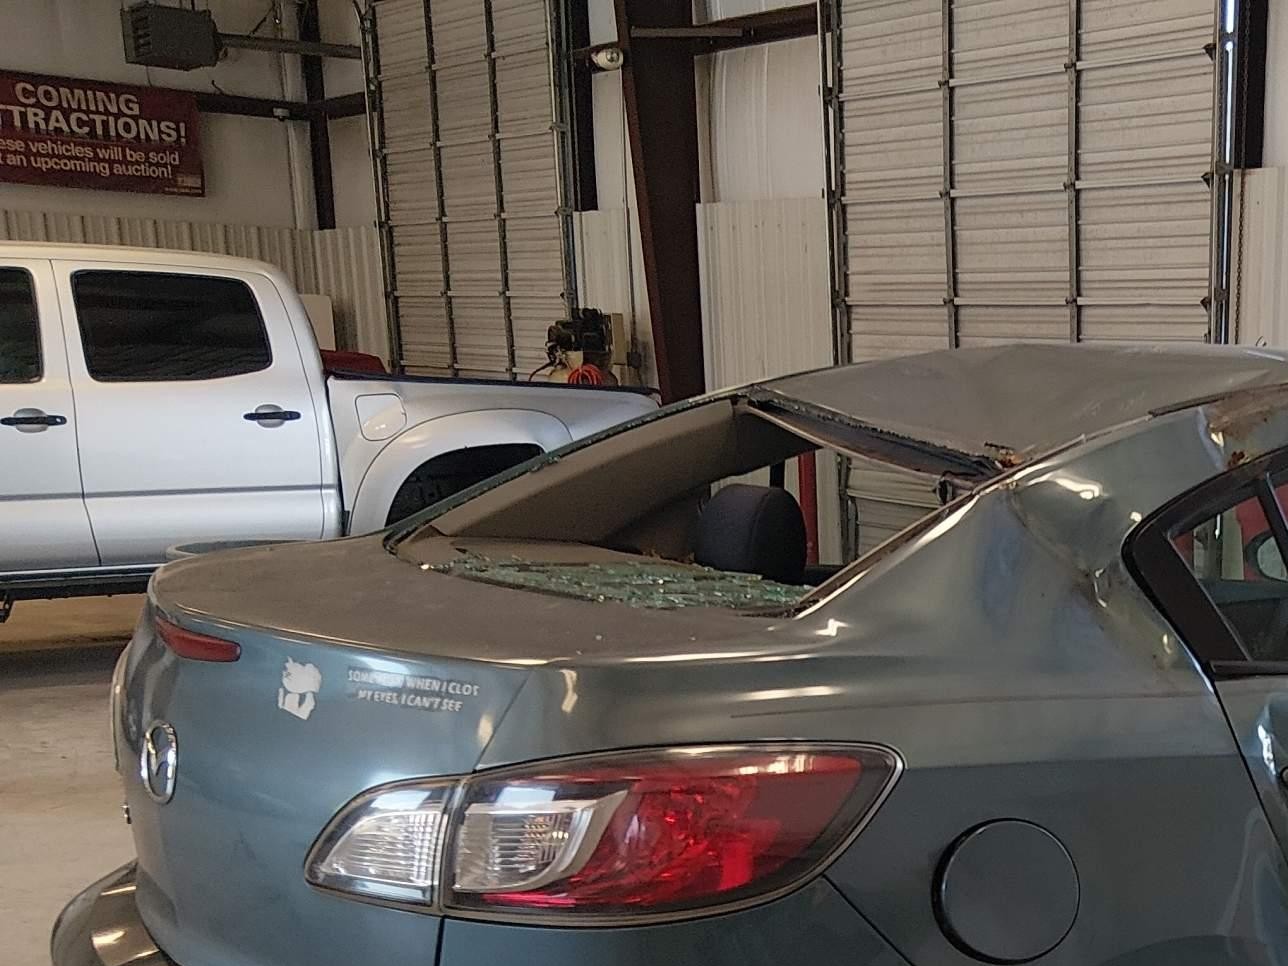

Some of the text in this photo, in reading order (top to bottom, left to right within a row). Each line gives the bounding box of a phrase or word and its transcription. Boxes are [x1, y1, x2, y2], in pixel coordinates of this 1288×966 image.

[15, 82, 140, 115] COMING
[27, 139, 94, 158] vehicles
[96, 146, 122, 161] will
[125, 147, 146, 162] be
[148, 150, 180, 165] sold
[7, 154, 27, 167] an
[30, 156, 110, 176] upcoming
[113, 162, 172, 179] auction!
